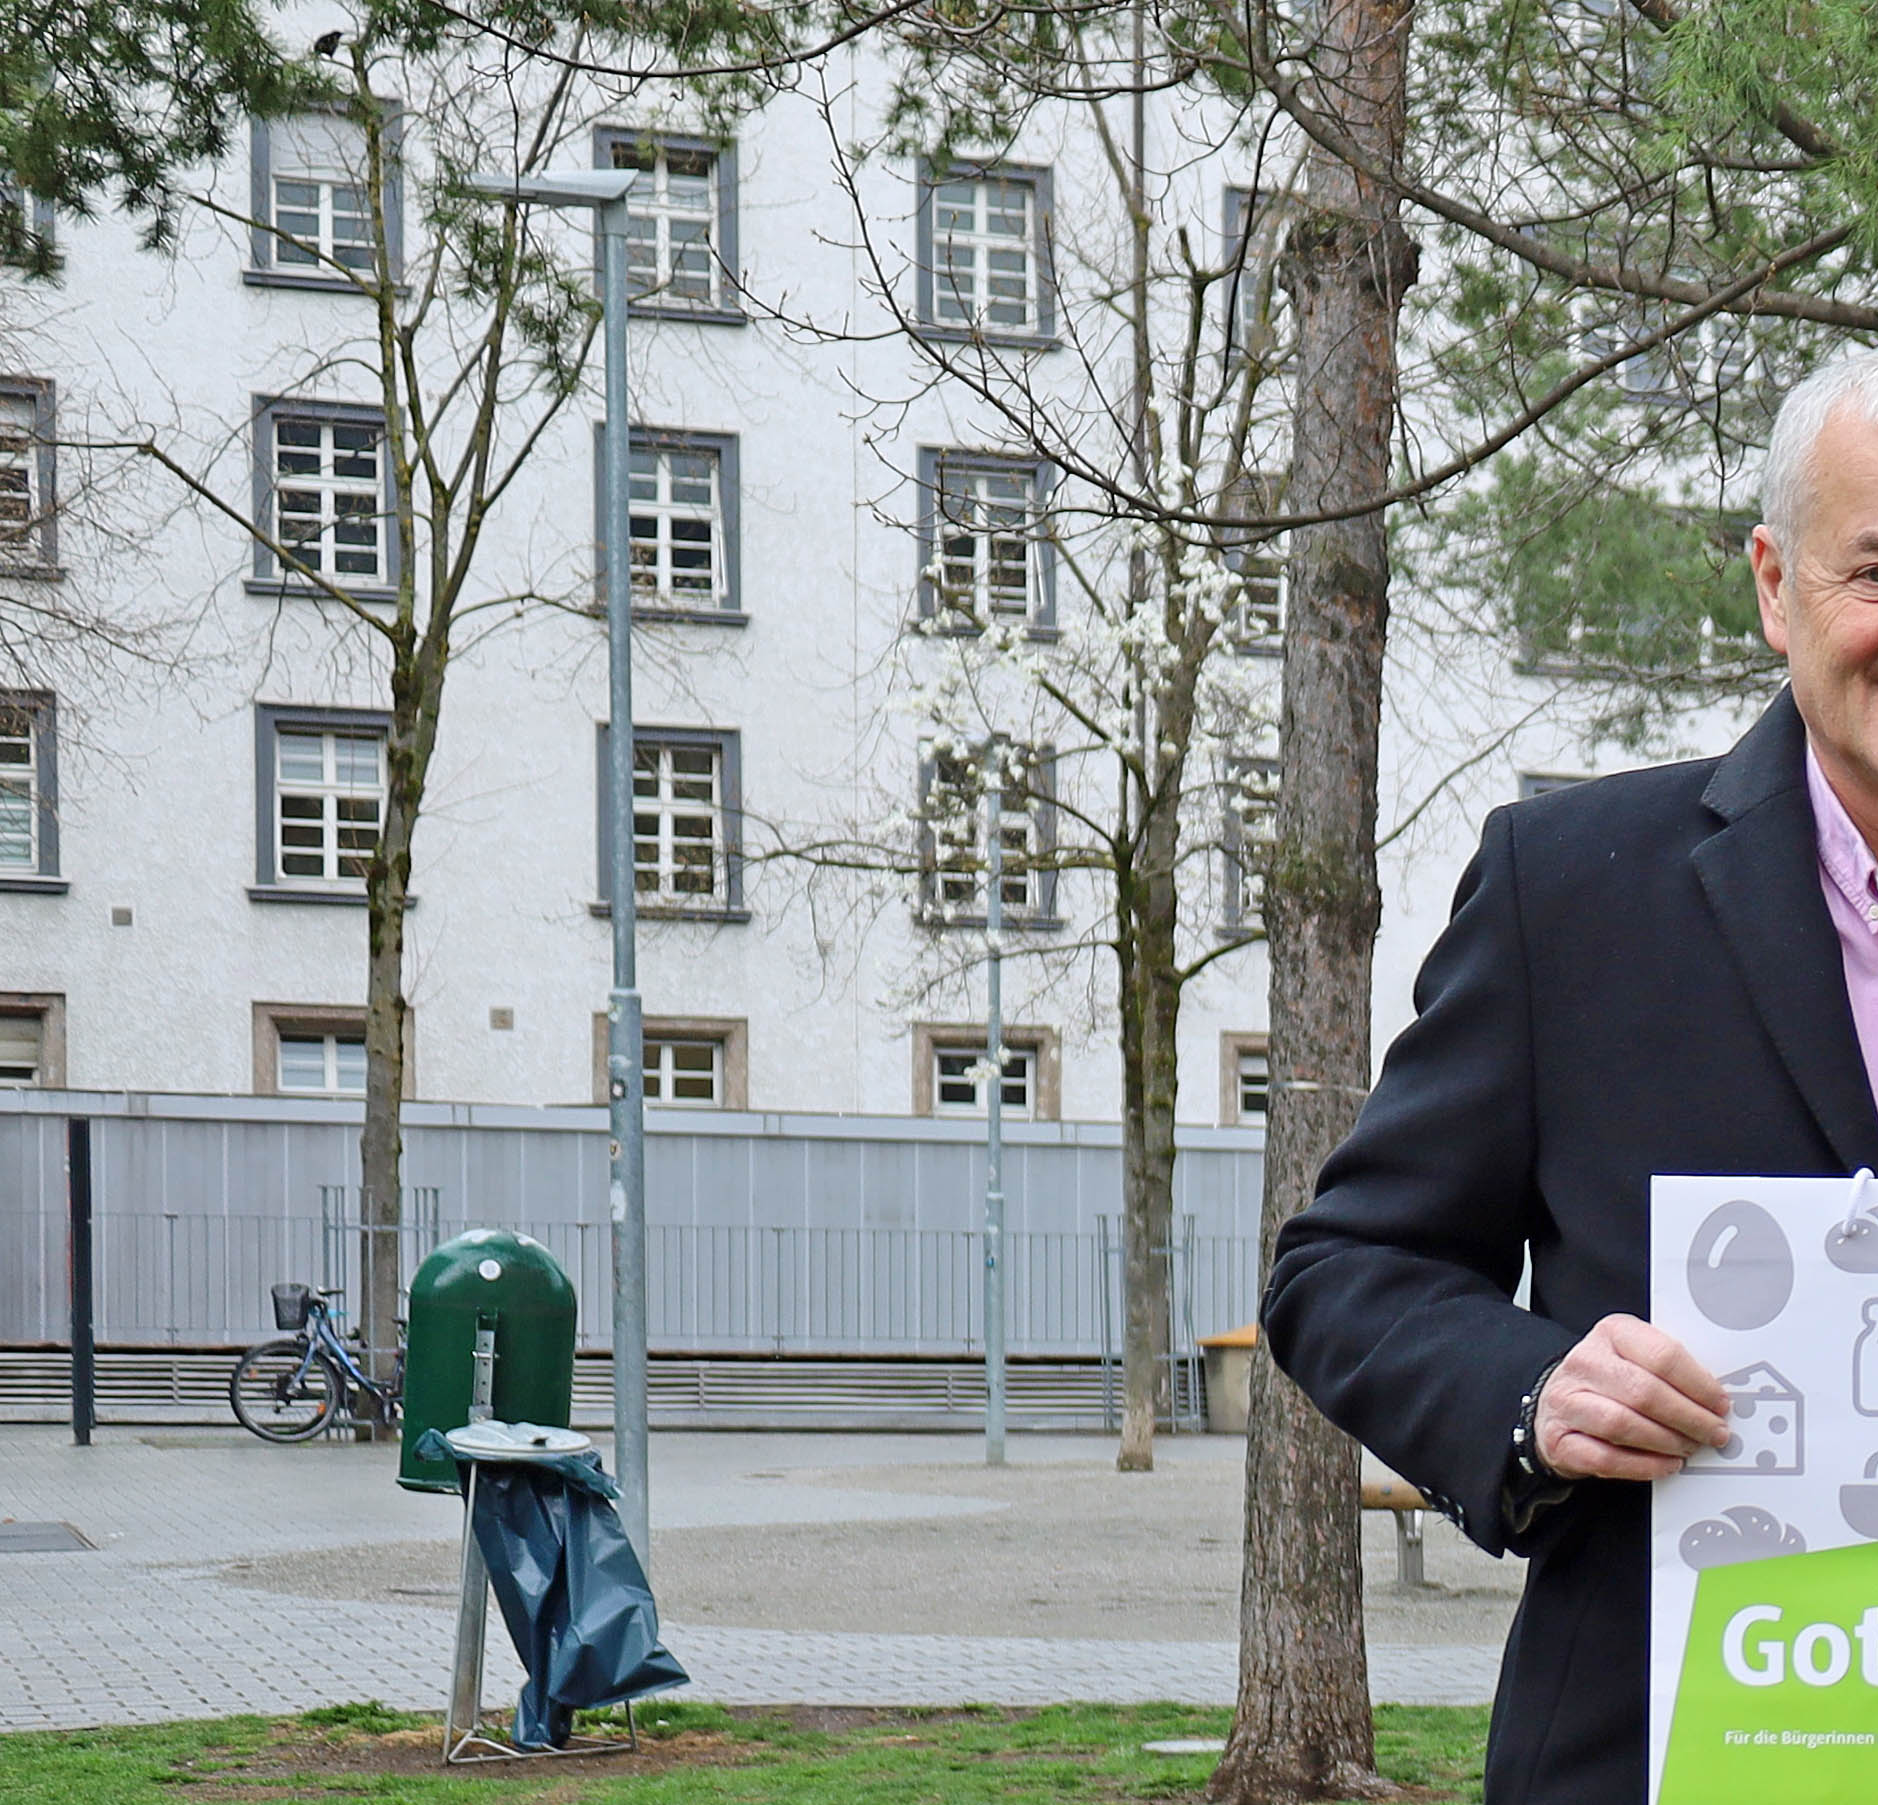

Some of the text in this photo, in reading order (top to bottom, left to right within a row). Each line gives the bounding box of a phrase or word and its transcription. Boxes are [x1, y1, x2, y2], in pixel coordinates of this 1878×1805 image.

[1724, 1730, 1751, 1745] Für
[1754, 1730, 1778, 1745] die
[1781, 1730, 1875, 1748] Bürgerinnen
